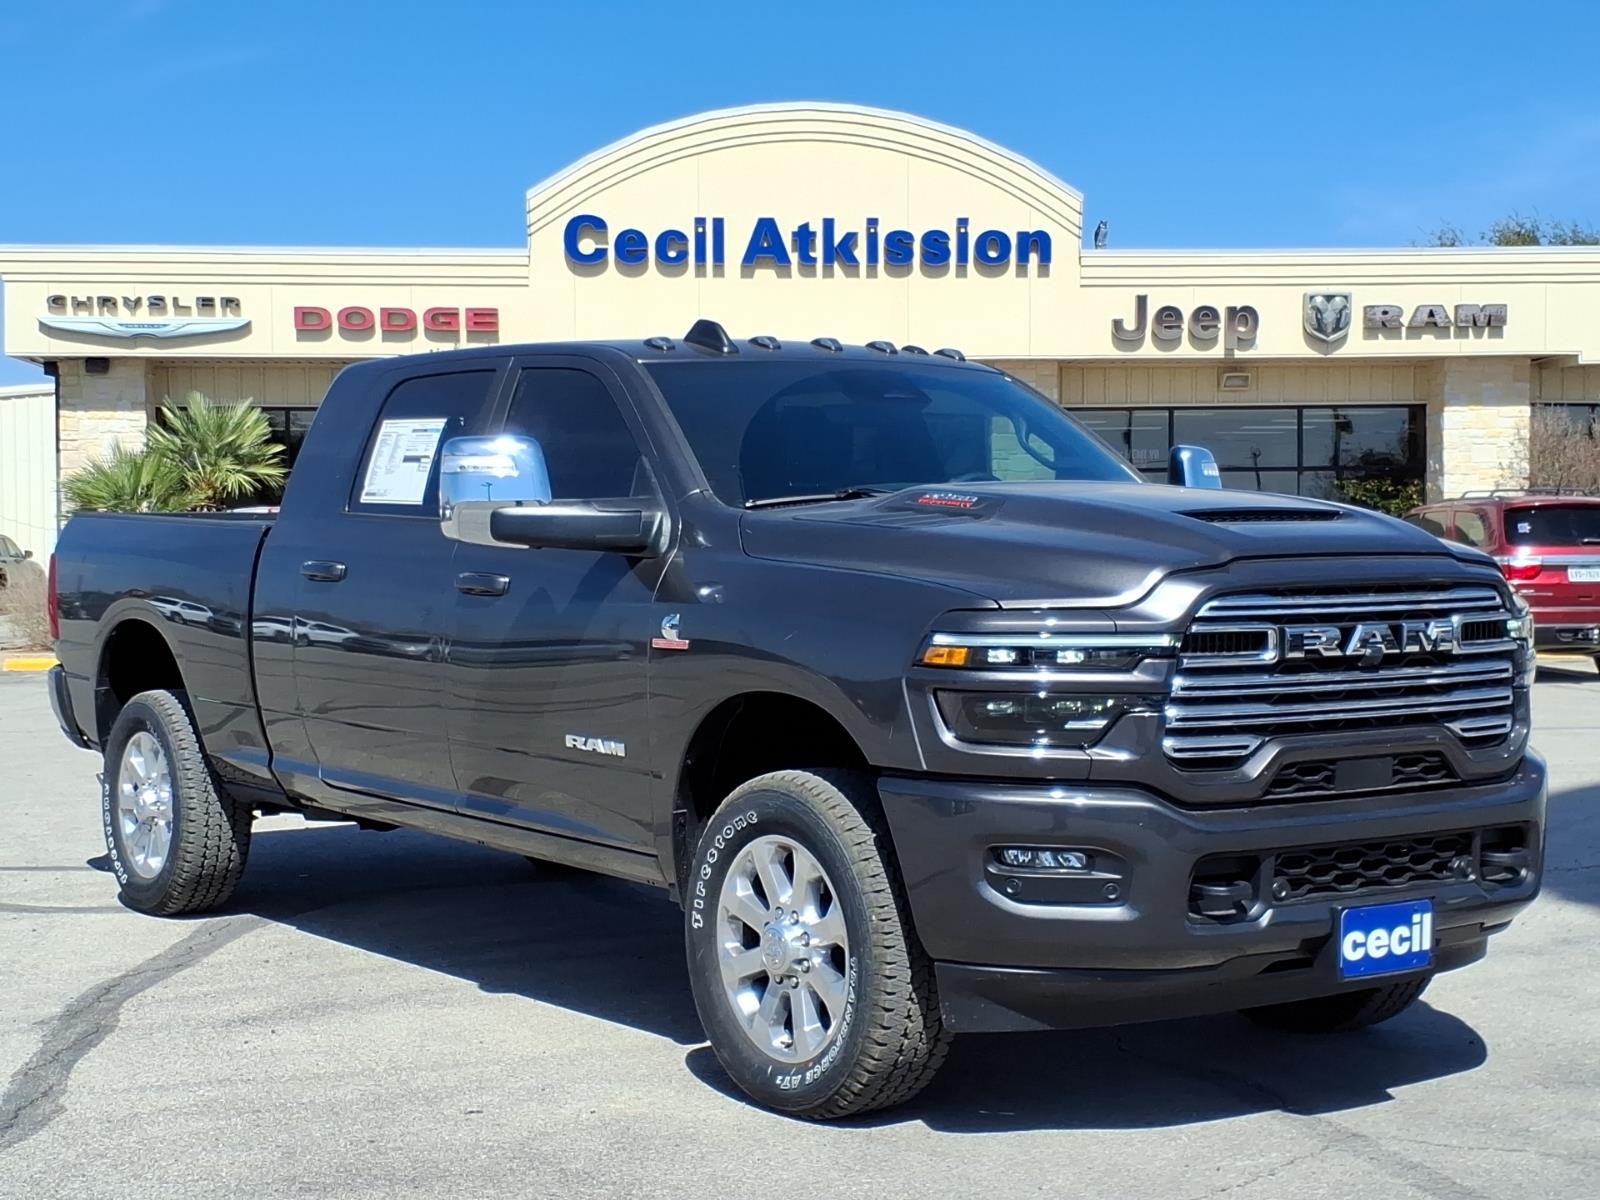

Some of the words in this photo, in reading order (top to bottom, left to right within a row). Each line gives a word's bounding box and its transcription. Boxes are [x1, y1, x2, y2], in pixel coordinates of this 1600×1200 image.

[564, 214, 725, 265] Cecil
[741, 217, 1052, 266] Atkission
[46, 294, 241, 317] CHRYSLER
[294, 306, 499, 331] DODGE
[1111, 294, 1260, 350] Jeep
[1363, 304, 1508, 328] RAM
[1285, 619, 1453, 657] RAM
[566, 734, 626, 757] RAM
[692, 811, 757, 929] Firestone
[1343, 912, 1432, 961] cecil
